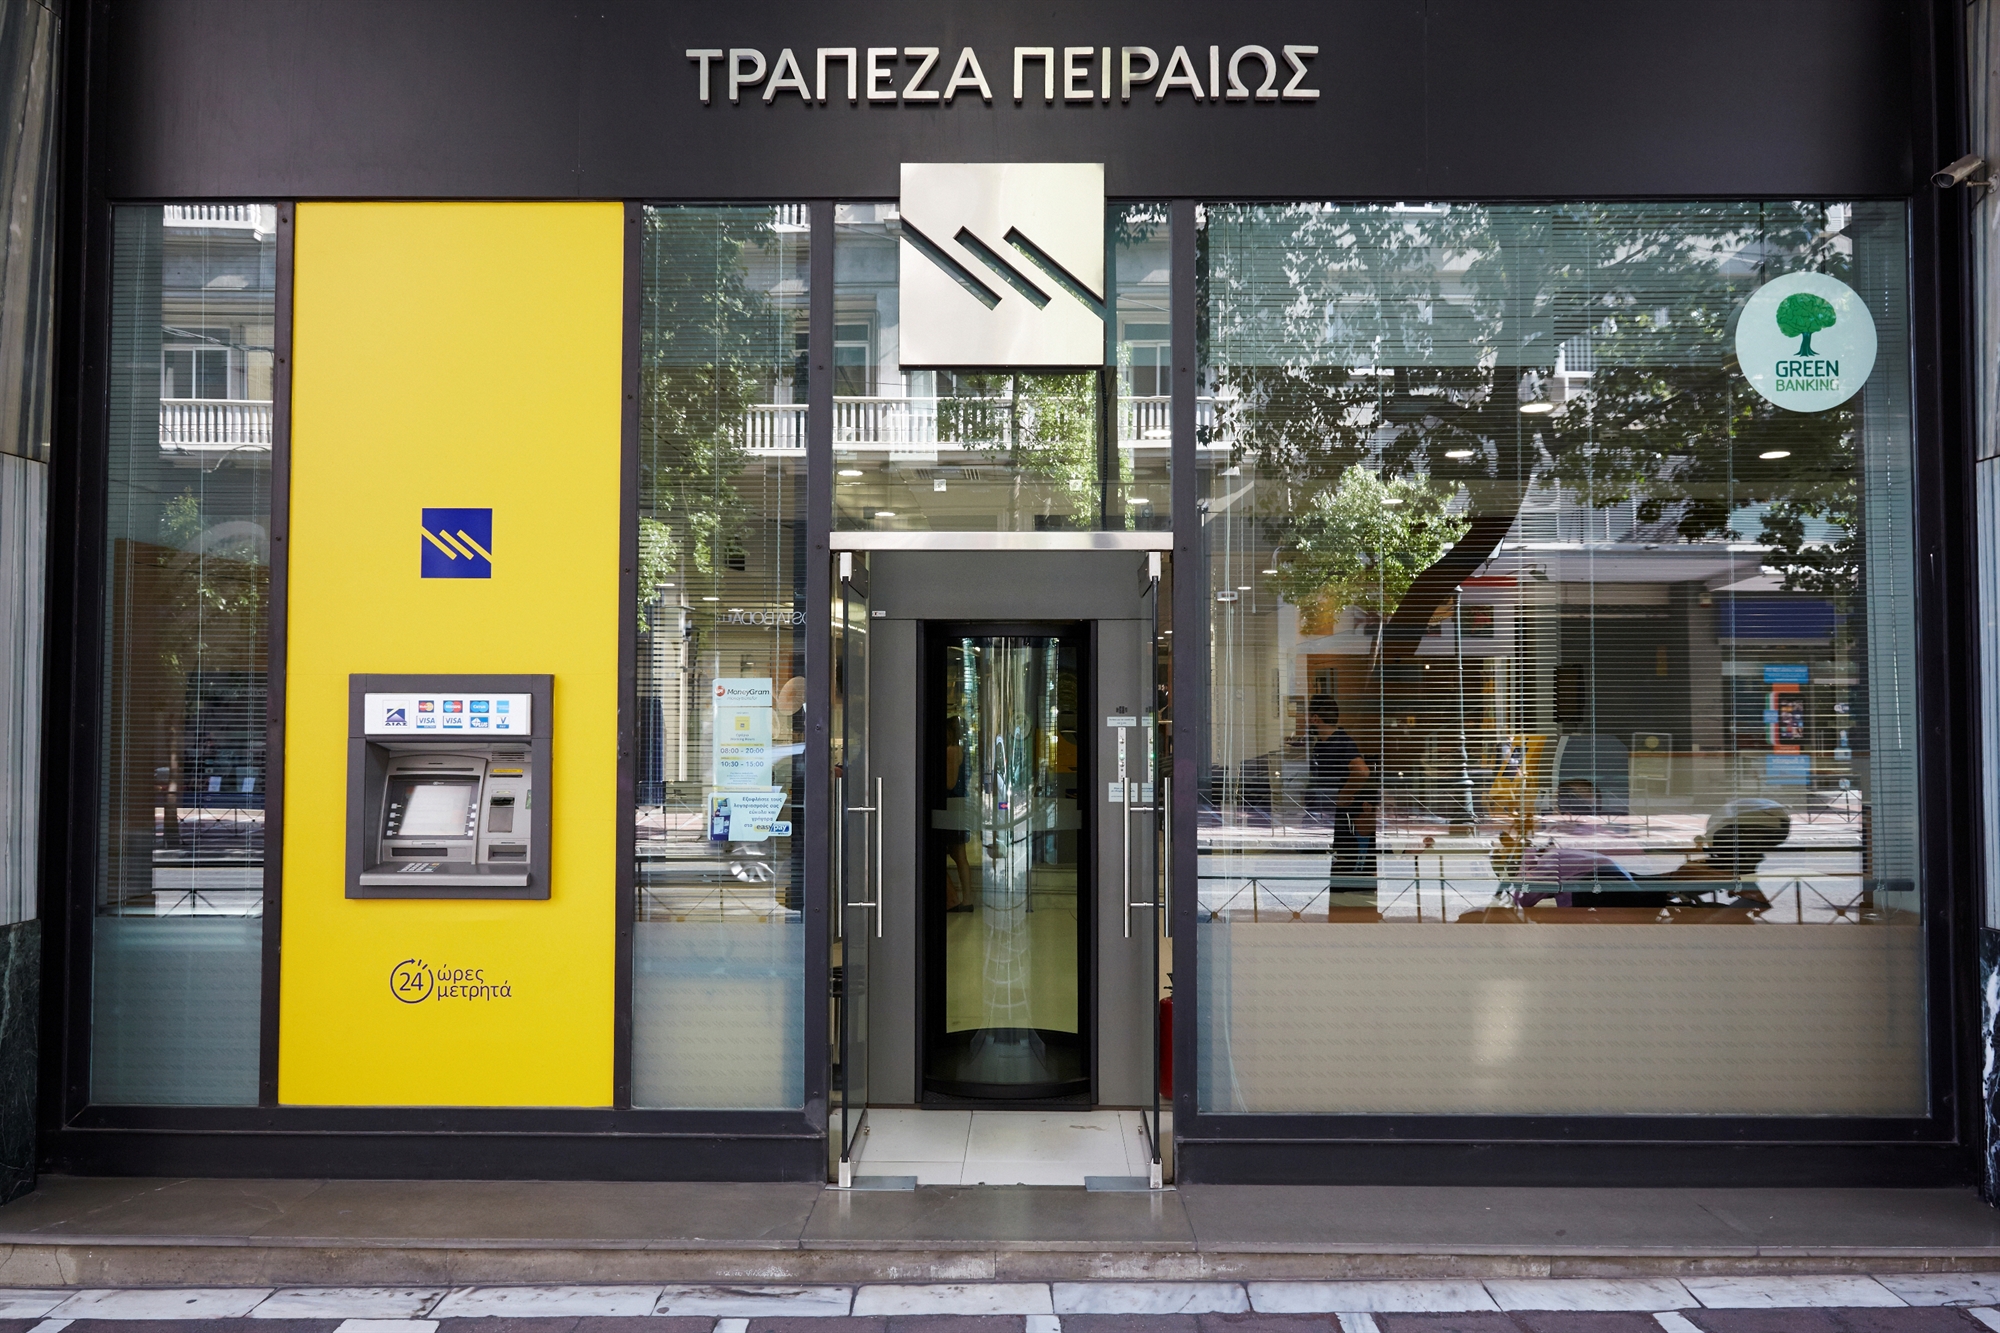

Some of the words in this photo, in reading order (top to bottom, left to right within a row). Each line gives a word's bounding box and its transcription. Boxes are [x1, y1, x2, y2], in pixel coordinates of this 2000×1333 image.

[686, 47, 993, 102] ΤΡΑΠΕΖΑ
[1013, 44, 1320, 100] ΠΕΙΡΑΙΩΣ
[1775, 360, 1839, 377] GREEN
[1775, 378, 1839, 392] BANKING
[727, 688, 770, 696] MoneyGram
[399, 972, 424, 991] 24
[437, 964, 484, 985] ώρες
[437, 980, 512, 1001] μετρητά
